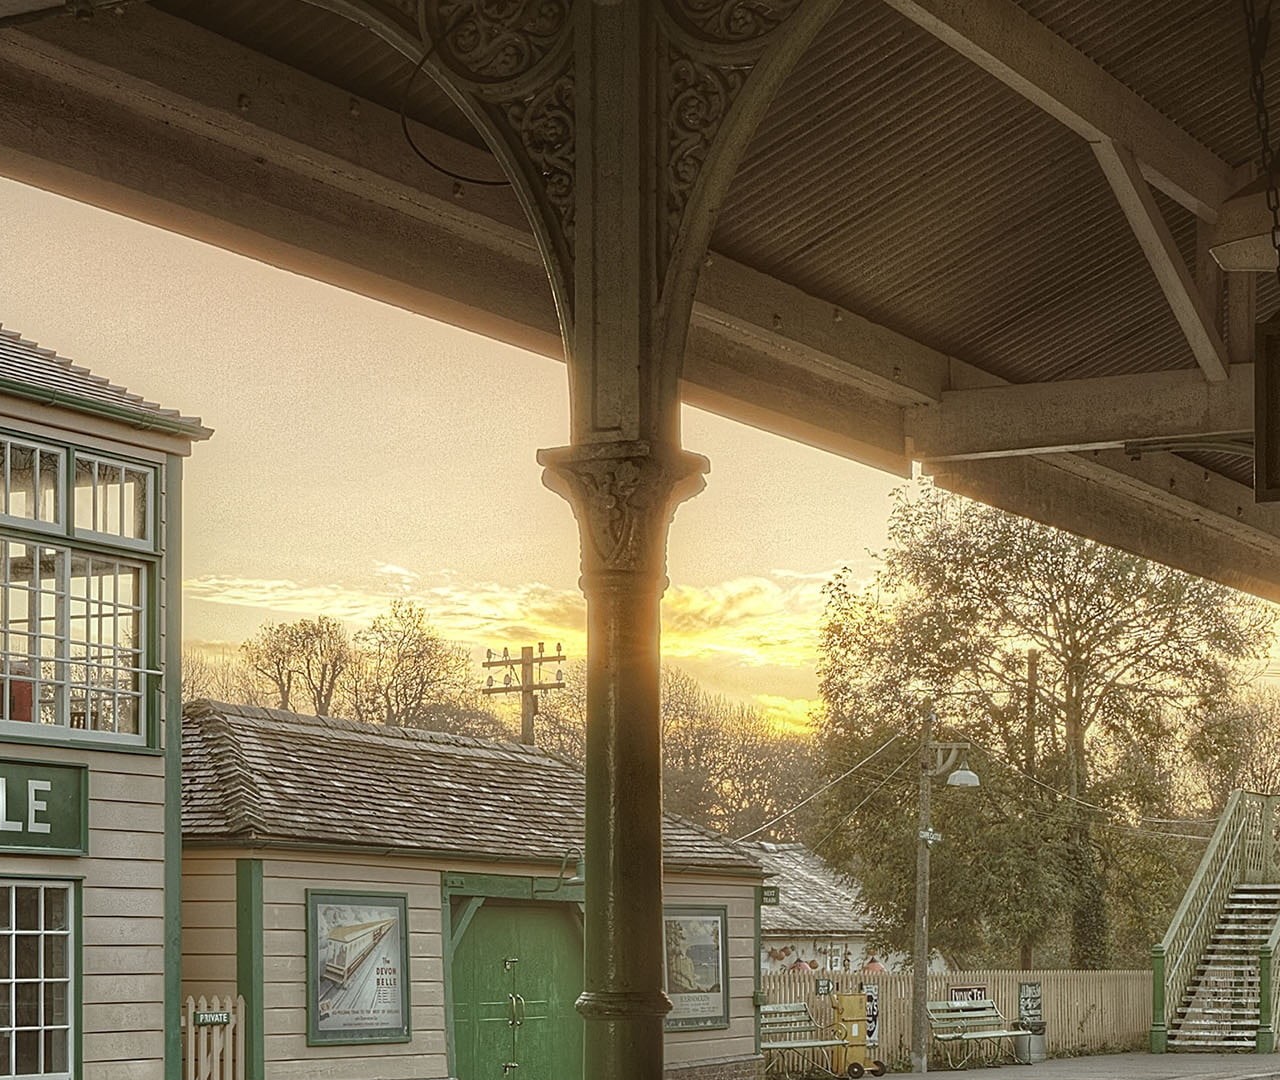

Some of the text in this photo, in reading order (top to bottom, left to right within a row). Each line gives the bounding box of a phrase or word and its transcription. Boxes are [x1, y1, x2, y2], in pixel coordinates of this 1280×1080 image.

[376, 967, 396, 975] DEVON
[377, 978, 397, 986] BELLE
[200, 1013, 228, 1023] PRIVATE
